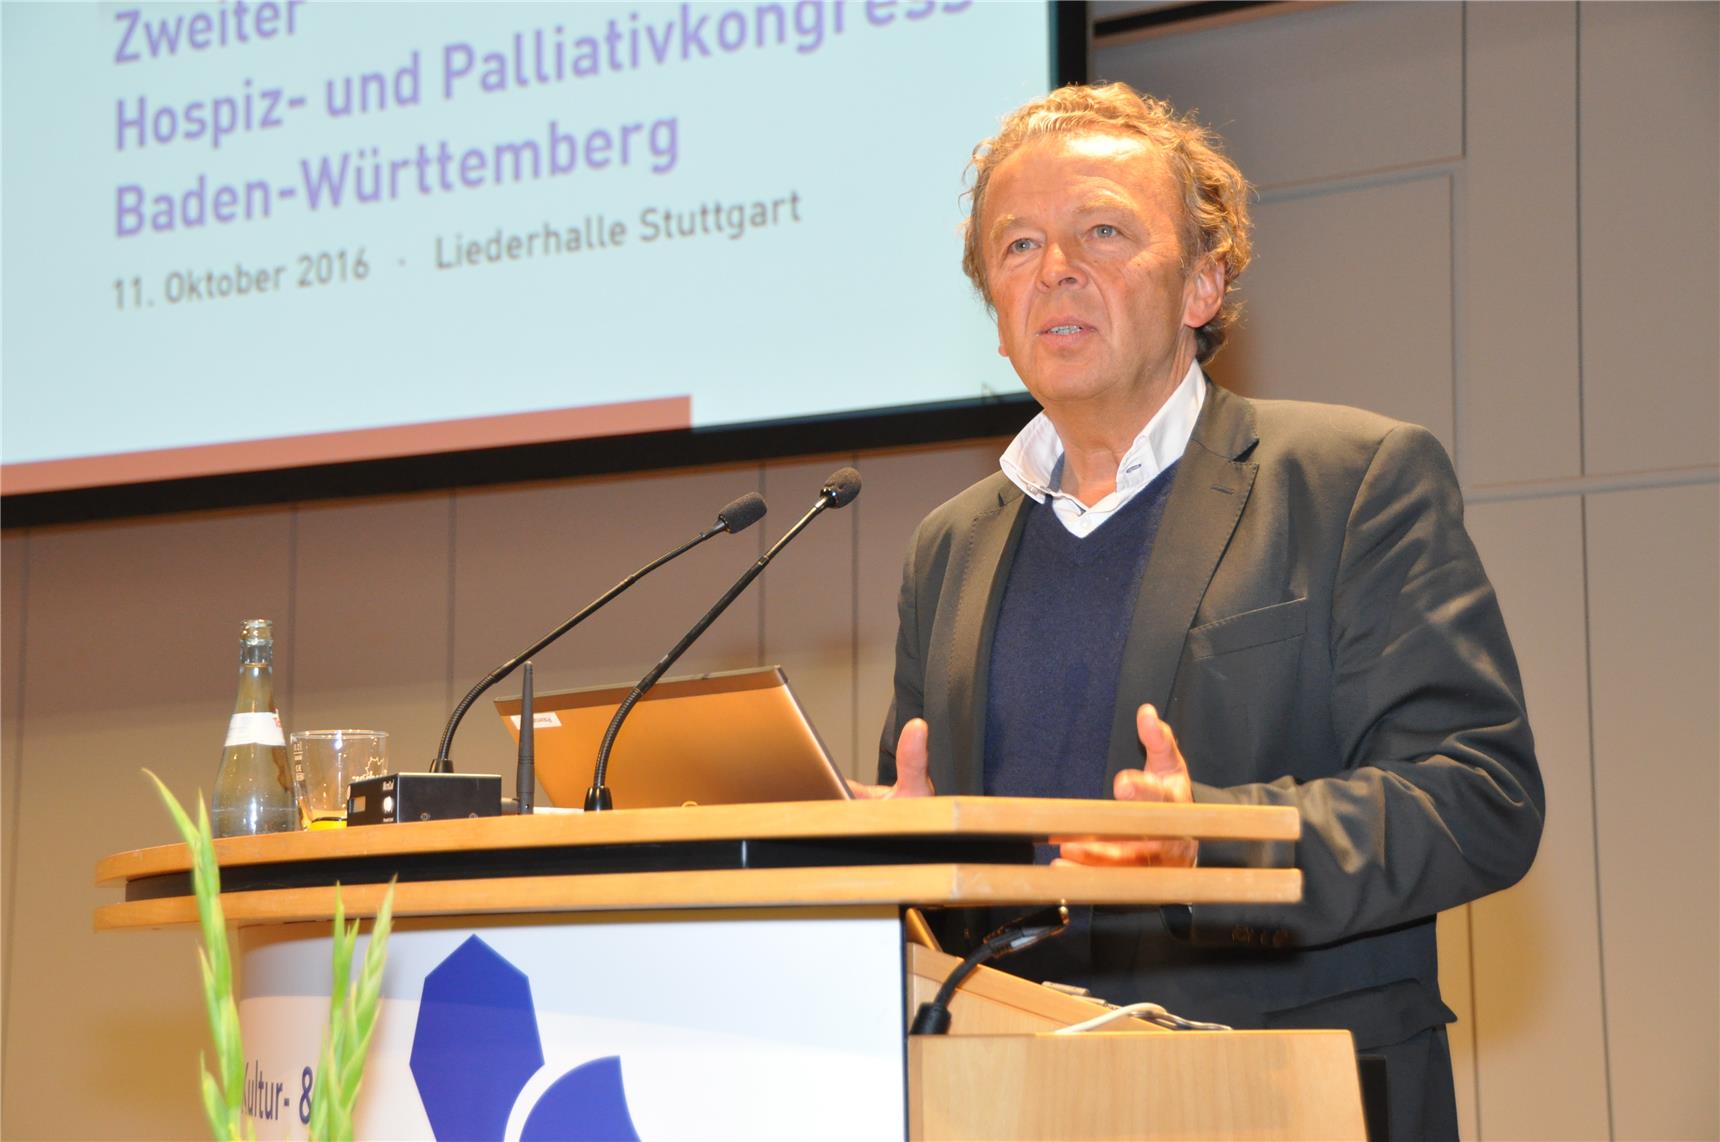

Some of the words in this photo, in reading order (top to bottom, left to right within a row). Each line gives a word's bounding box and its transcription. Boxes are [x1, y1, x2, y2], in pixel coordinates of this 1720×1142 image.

[113, 0, 305, 65] Zweiter
[115, 77, 308, 152] Hospiz-
[325, 49, 421, 118] und
[441, 0, 974, 100] Palliativkongre
[114, 116, 680, 238] Baden-Württemberg
[112, 278, 154, 310] 11.
[164, 262, 287, 305] Oktober
[296, 248, 370, 289] 2016
[434, 215, 628, 270] Liederhalle
[639, 190, 802, 242] Stuttgart
